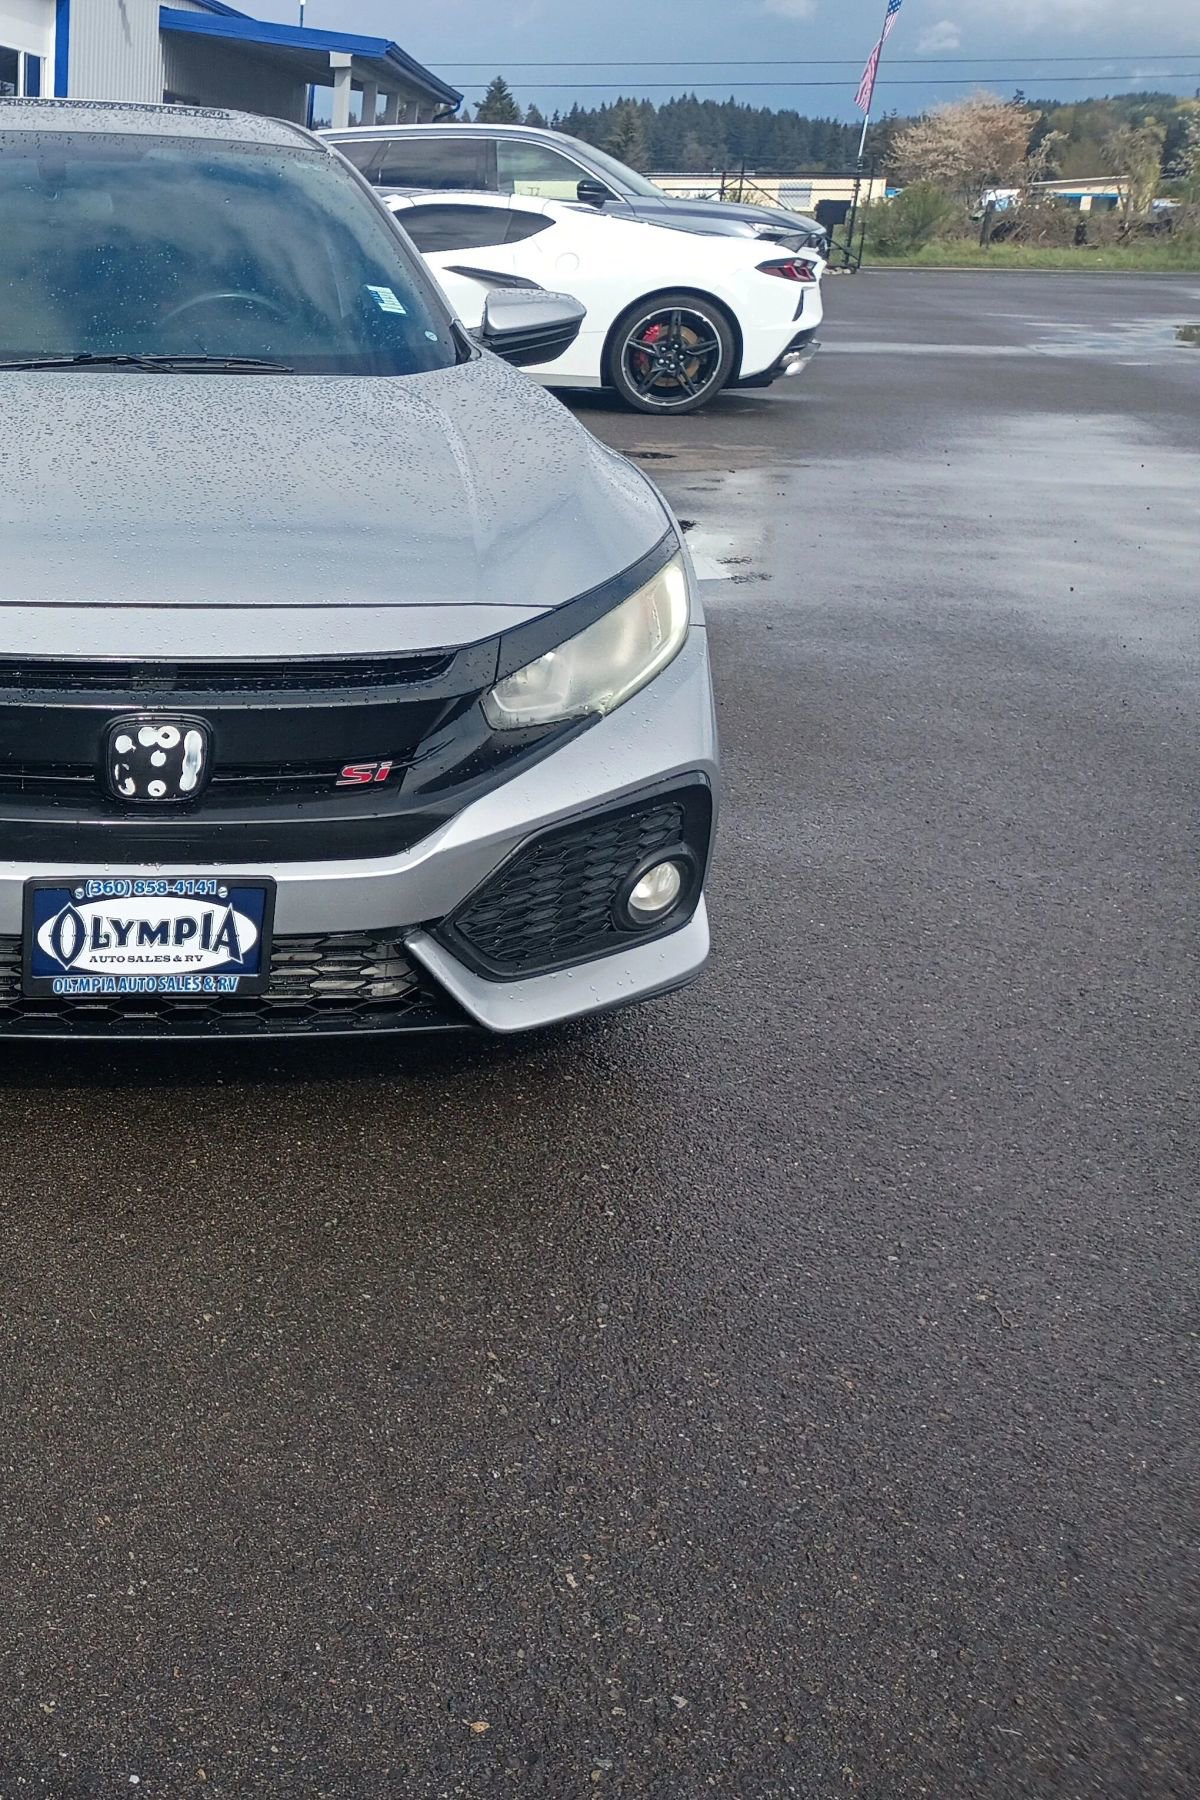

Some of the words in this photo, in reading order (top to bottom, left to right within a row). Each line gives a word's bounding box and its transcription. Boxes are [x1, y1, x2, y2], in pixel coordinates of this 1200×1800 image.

[336, 761, 393, 785] Si
[85, 880, 131, 897] (360)
[133, 880, 217, 896] 858-4141
[49, 902, 244, 970] OLYMPIA
[89, 955, 126, 963] AUTO
[127, 954, 171, 963] SALES
[184, 954, 204, 962] RV
[117, 977, 155, 993] AUTO
[158, 976, 201, 993] SALES
[202, 977, 215, 992] &
[217, 976, 240, 992] RV
